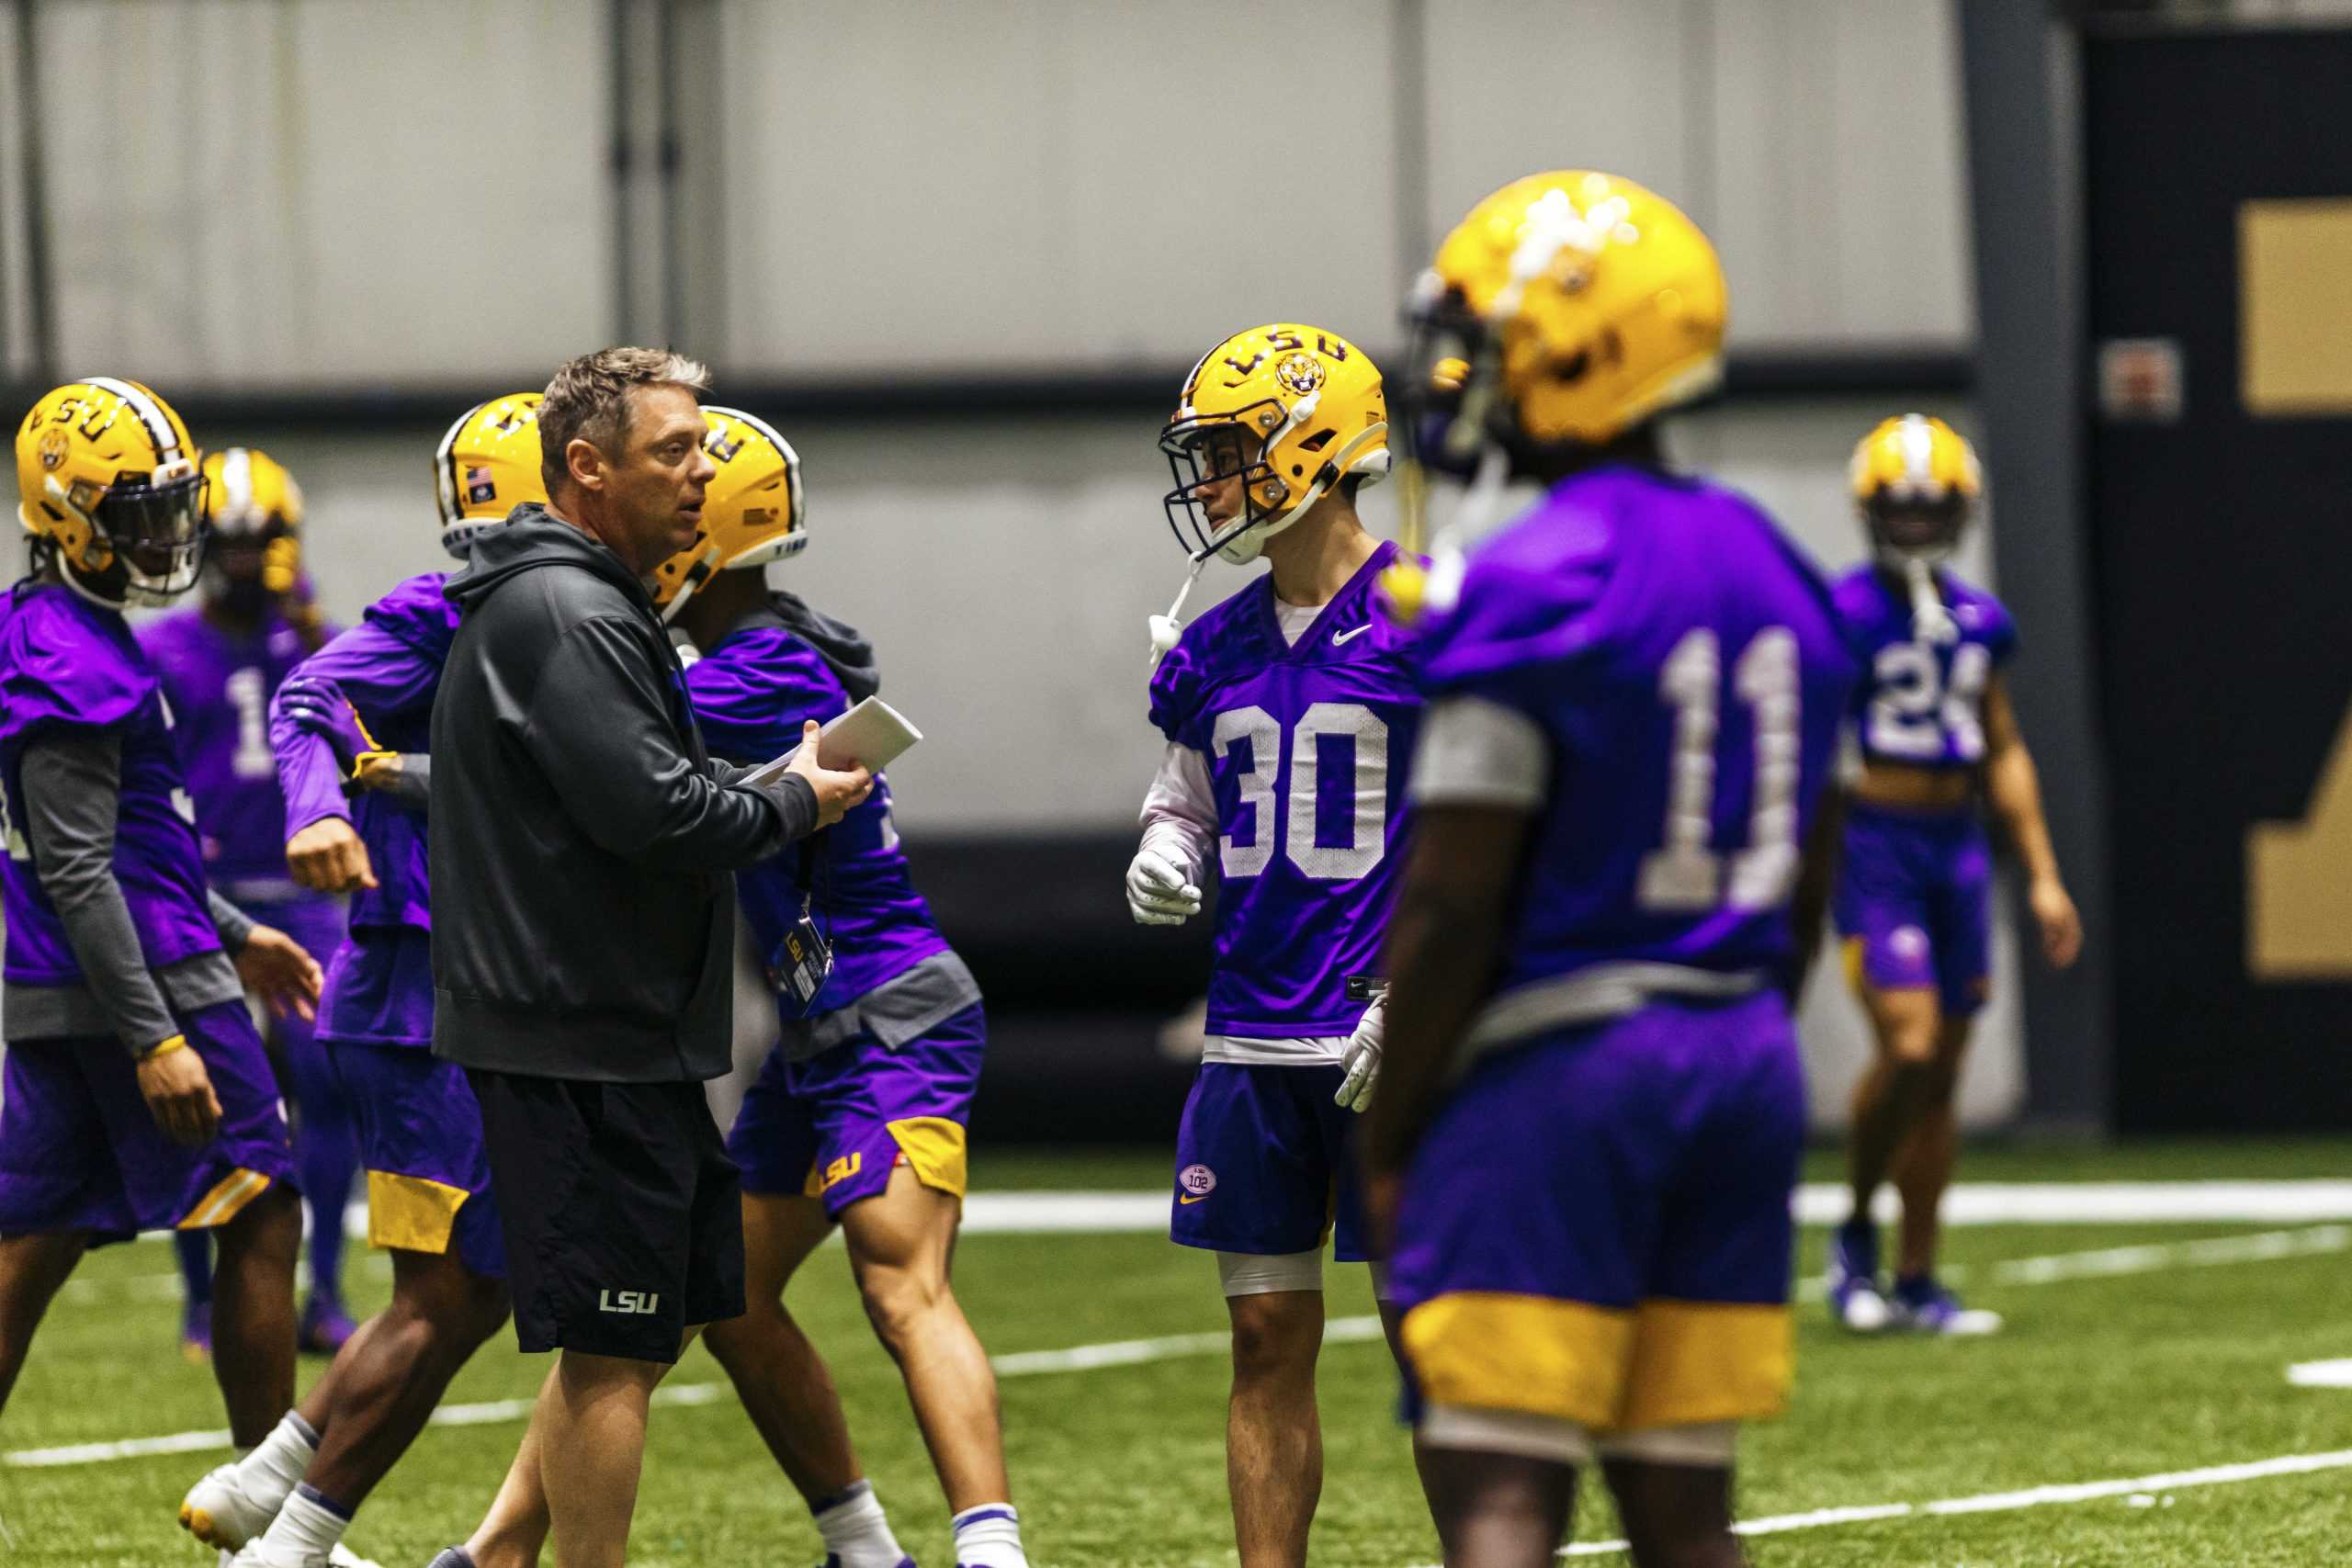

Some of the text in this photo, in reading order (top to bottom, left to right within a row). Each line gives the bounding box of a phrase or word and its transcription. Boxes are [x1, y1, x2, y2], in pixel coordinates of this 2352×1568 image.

[1224, 330, 1348, 363] LSU
[1635, 625, 1800, 910] 11
[1211, 702, 1388, 879] 30
[1189, 1175, 1208, 1190] 102
[599, 1289, 659, 1314] LSU
